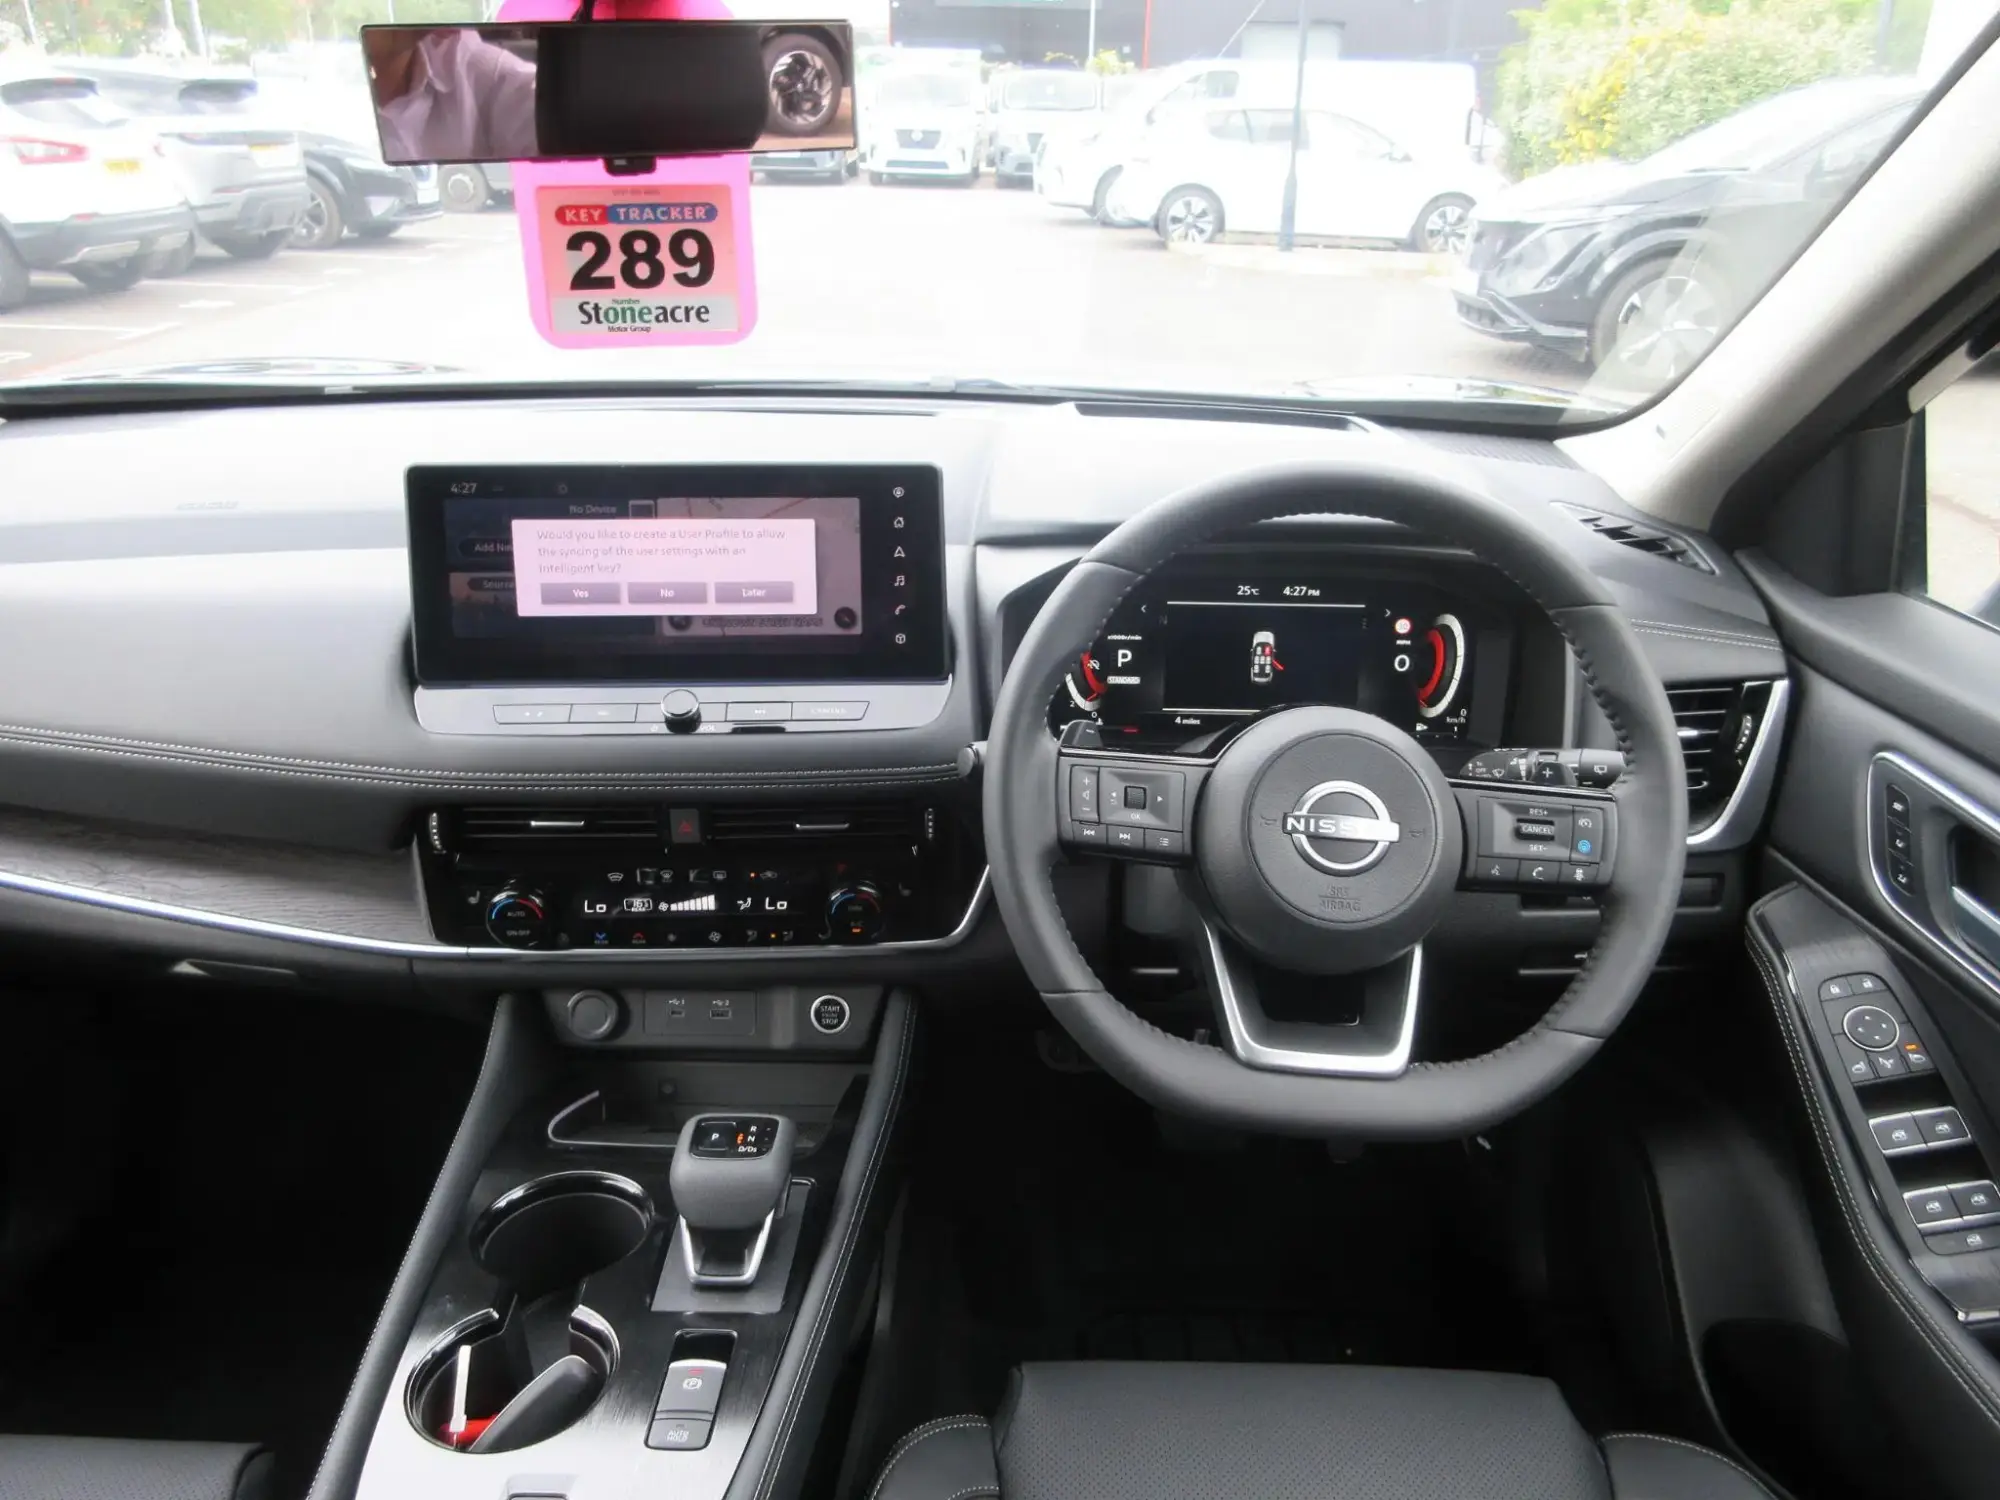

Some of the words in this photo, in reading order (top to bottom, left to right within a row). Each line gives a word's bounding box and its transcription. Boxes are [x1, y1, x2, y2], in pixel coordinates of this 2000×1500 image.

[564, 207, 602, 223] KEY
[615, 205, 708, 222] TRACKER
[565, 228, 716, 291] 289
[578, 300, 711, 326] Stoneacre
[607, 325, 627, 333] Motor
[630, 325, 651, 334] Group
[450, 482, 477, 493] 4:27
[568, 504, 582, 514] No
[585, 504, 617, 514] Device
[536, 529, 572, 540] Would
[574, 530, 595, 542] you
[597, 528, 617, 539] like
[619, 529, 630, 539] to
[633, 529, 667, 539] create
[677, 529, 701, 539] User
[704, 527, 740, 539] Profile
[742, 528, 753, 538] to
[756, 528, 785, 539] allow
[473, 542, 493, 552] Add
[537, 546, 556, 556] the
[559, 547, 599, 558] syncing
[600, 545, 612, 555] of
[615, 545, 633, 555] the
[636, 547, 657, 556] user
[660, 545, 702, 557] settings
[704, 545, 729, 555] with
[732, 546, 746, 555] an
[597, 562, 621, 574] key?
[572, 588, 589, 598] Yes
[659, 587, 675, 597] No
[741, 587, 766, 597] Later
[1282, 586, 1306, 596] 4:27
[1307, 589, 1320, 597] PM
[1116, 649, 1132, 667] P
[1393, 654, 1410, 671] 0
[1107, 676, 1140, 685] STANDARD
[1069, 700, 1076, 708] 2
[1091, 711, 1098, 719] 0
[1460, 708, 1468, 717] 0
[1174, 716, 1182, 724] 4
[1182, 717, 1200, 726] miles
[1446, 716, 1466, 724] km/h
[1130, 812, 1140, 821] OK
[1528, 807, 1548, 816] RES+
[1520, 824, 1552, 834] CANCEL
[584, 899, 606, 913] Lo
[765, 896, 787, 909] Lo
[1318, 900, 1361, 911] AIRBAG
[506, 910, 525, 918] AUTO
[819, 1004, 840, 1013] START
[821, 1018, 839, 1026] STOP
[750, 1125, 758, 1133] R
[711, 1133, 720, 1141] P
[747, 1135, 756, 1143] N
[668, 1429, 690, 1437] AUTO
